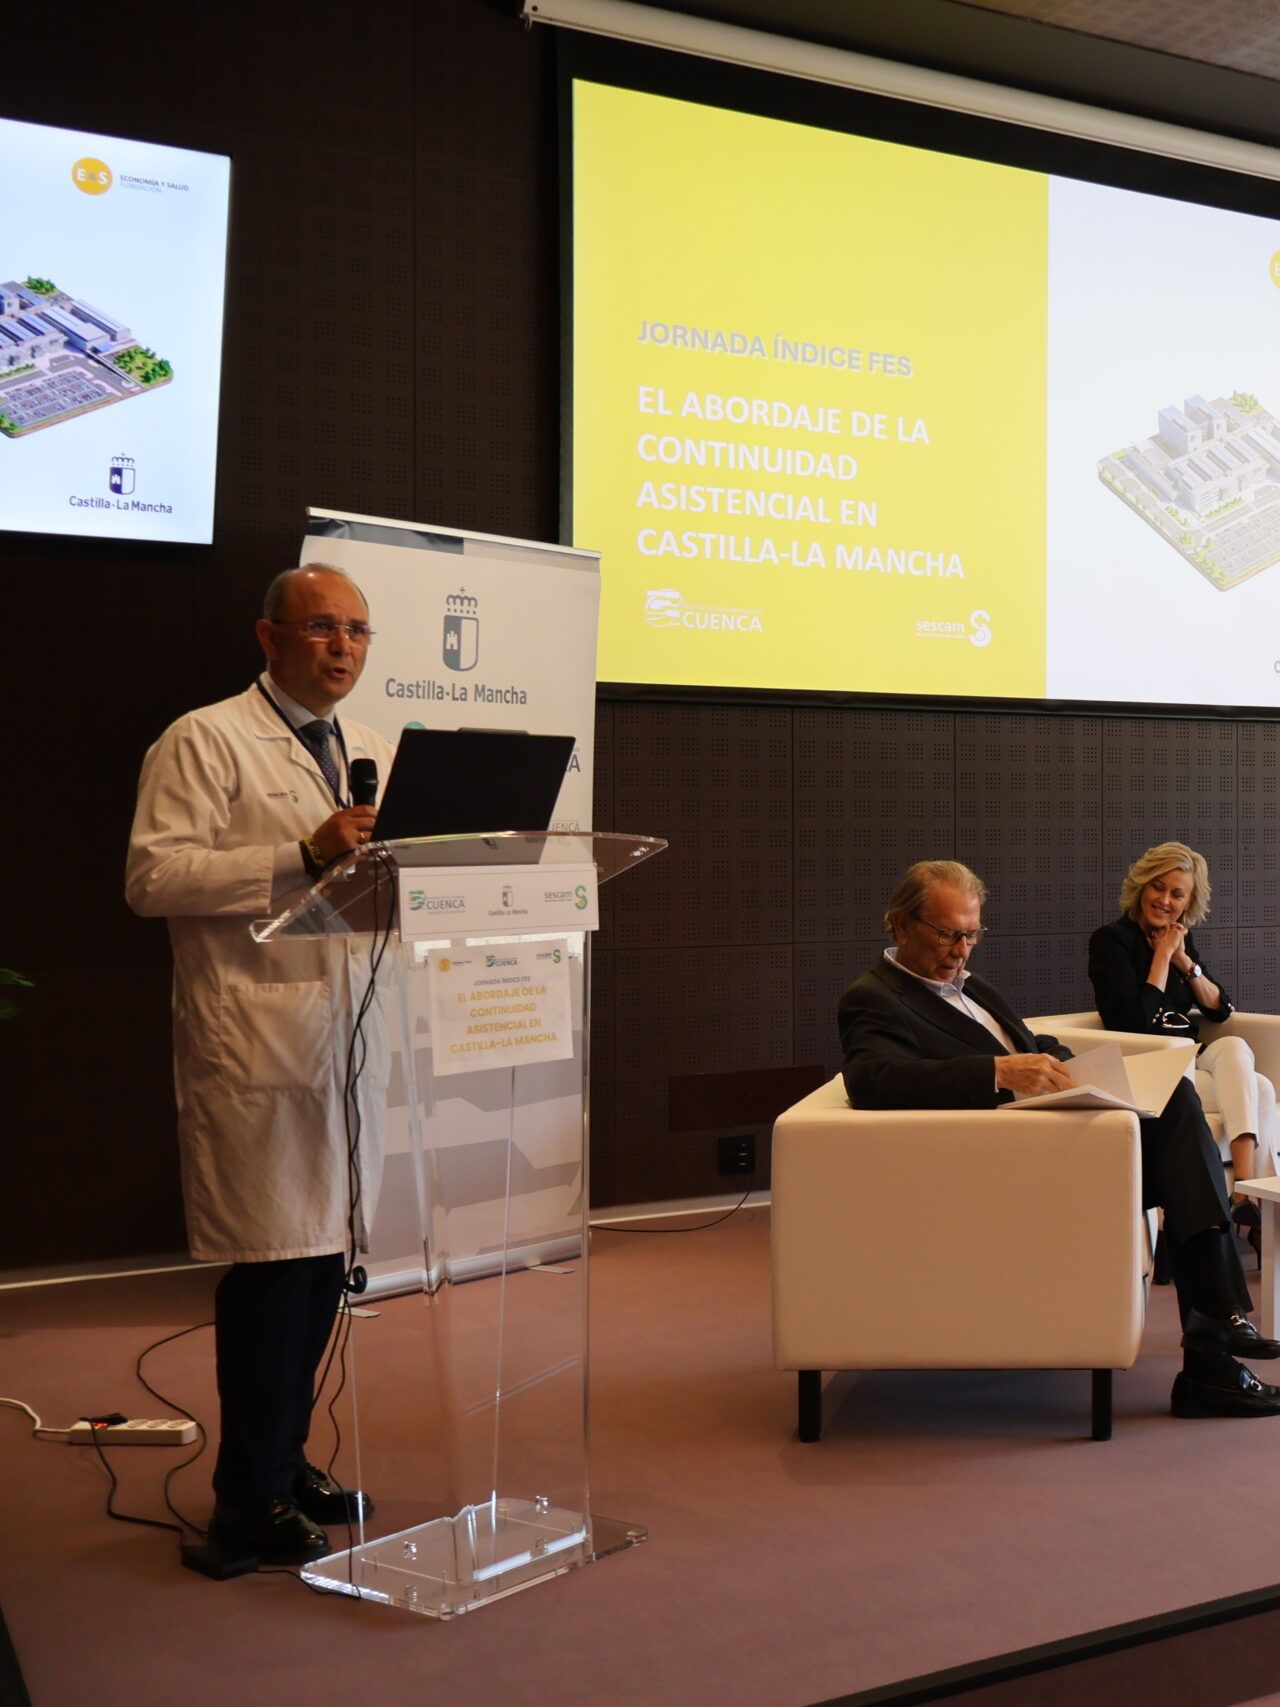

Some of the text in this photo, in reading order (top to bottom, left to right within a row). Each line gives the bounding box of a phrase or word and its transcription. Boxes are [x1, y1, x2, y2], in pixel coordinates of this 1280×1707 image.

[637, 319, 914, 378] JORNADA ÍNDICE FES
[638, 385, 930, 444] EL ABORDAJE DE LA
[637, 433, 858, 481] CONTINUIDAD
[69, 495, 173, 514] Castilla-La Mancha
[636, 481, 878, 527] ASISTENCIAL EN
[636, 528, 965, 579] CASTILLA-LA MANCHA
[683, 611, 763, 632] CUENCA
[915, 617, 965, 633] sescam
[385, 678, 527, 705] Castilla-La Mancha
[426, 899, 465, 910] CUENCA
[544, 891, 573, 899] sescam
[457, 985, 547, 1003] EL ABORDAJE DE LA
[470, 1003, 537, 1017] CONTINUIDAD
[466, 1018, 541, 1034] ASISTENCIAL EN
[450, 1032, 557, 1053] CASTILLA-LA MANCHA
